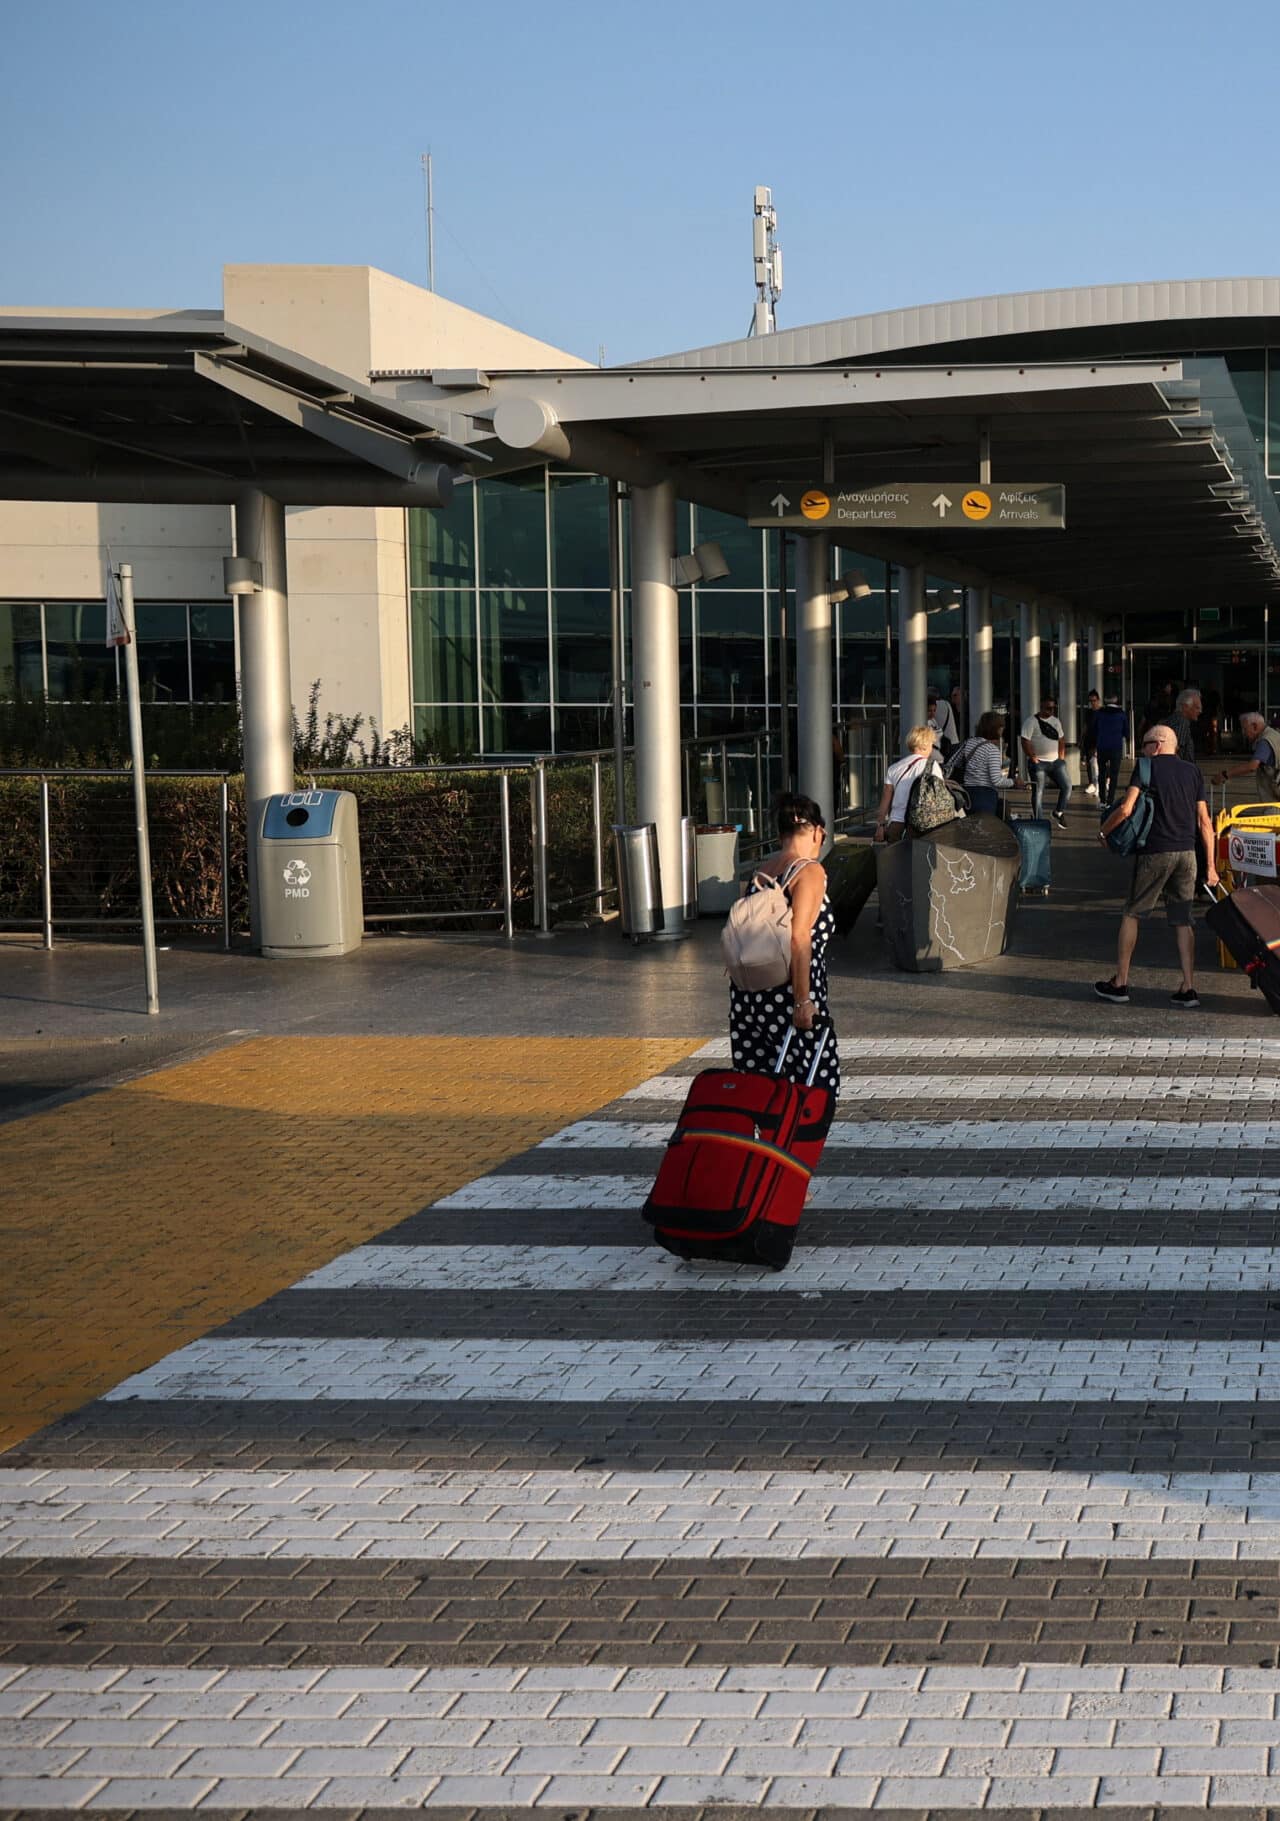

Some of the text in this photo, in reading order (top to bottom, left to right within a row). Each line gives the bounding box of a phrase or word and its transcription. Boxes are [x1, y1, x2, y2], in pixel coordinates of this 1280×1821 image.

[837, 491, 909, 504] Αναχωρήσεις
[999, 491, 1039, 504] Αφίξεις
[837, 508, 897, 520] Departures
[999, 509, 1039, 520] Arrivals
[285, 888, 310, 898] PMD
